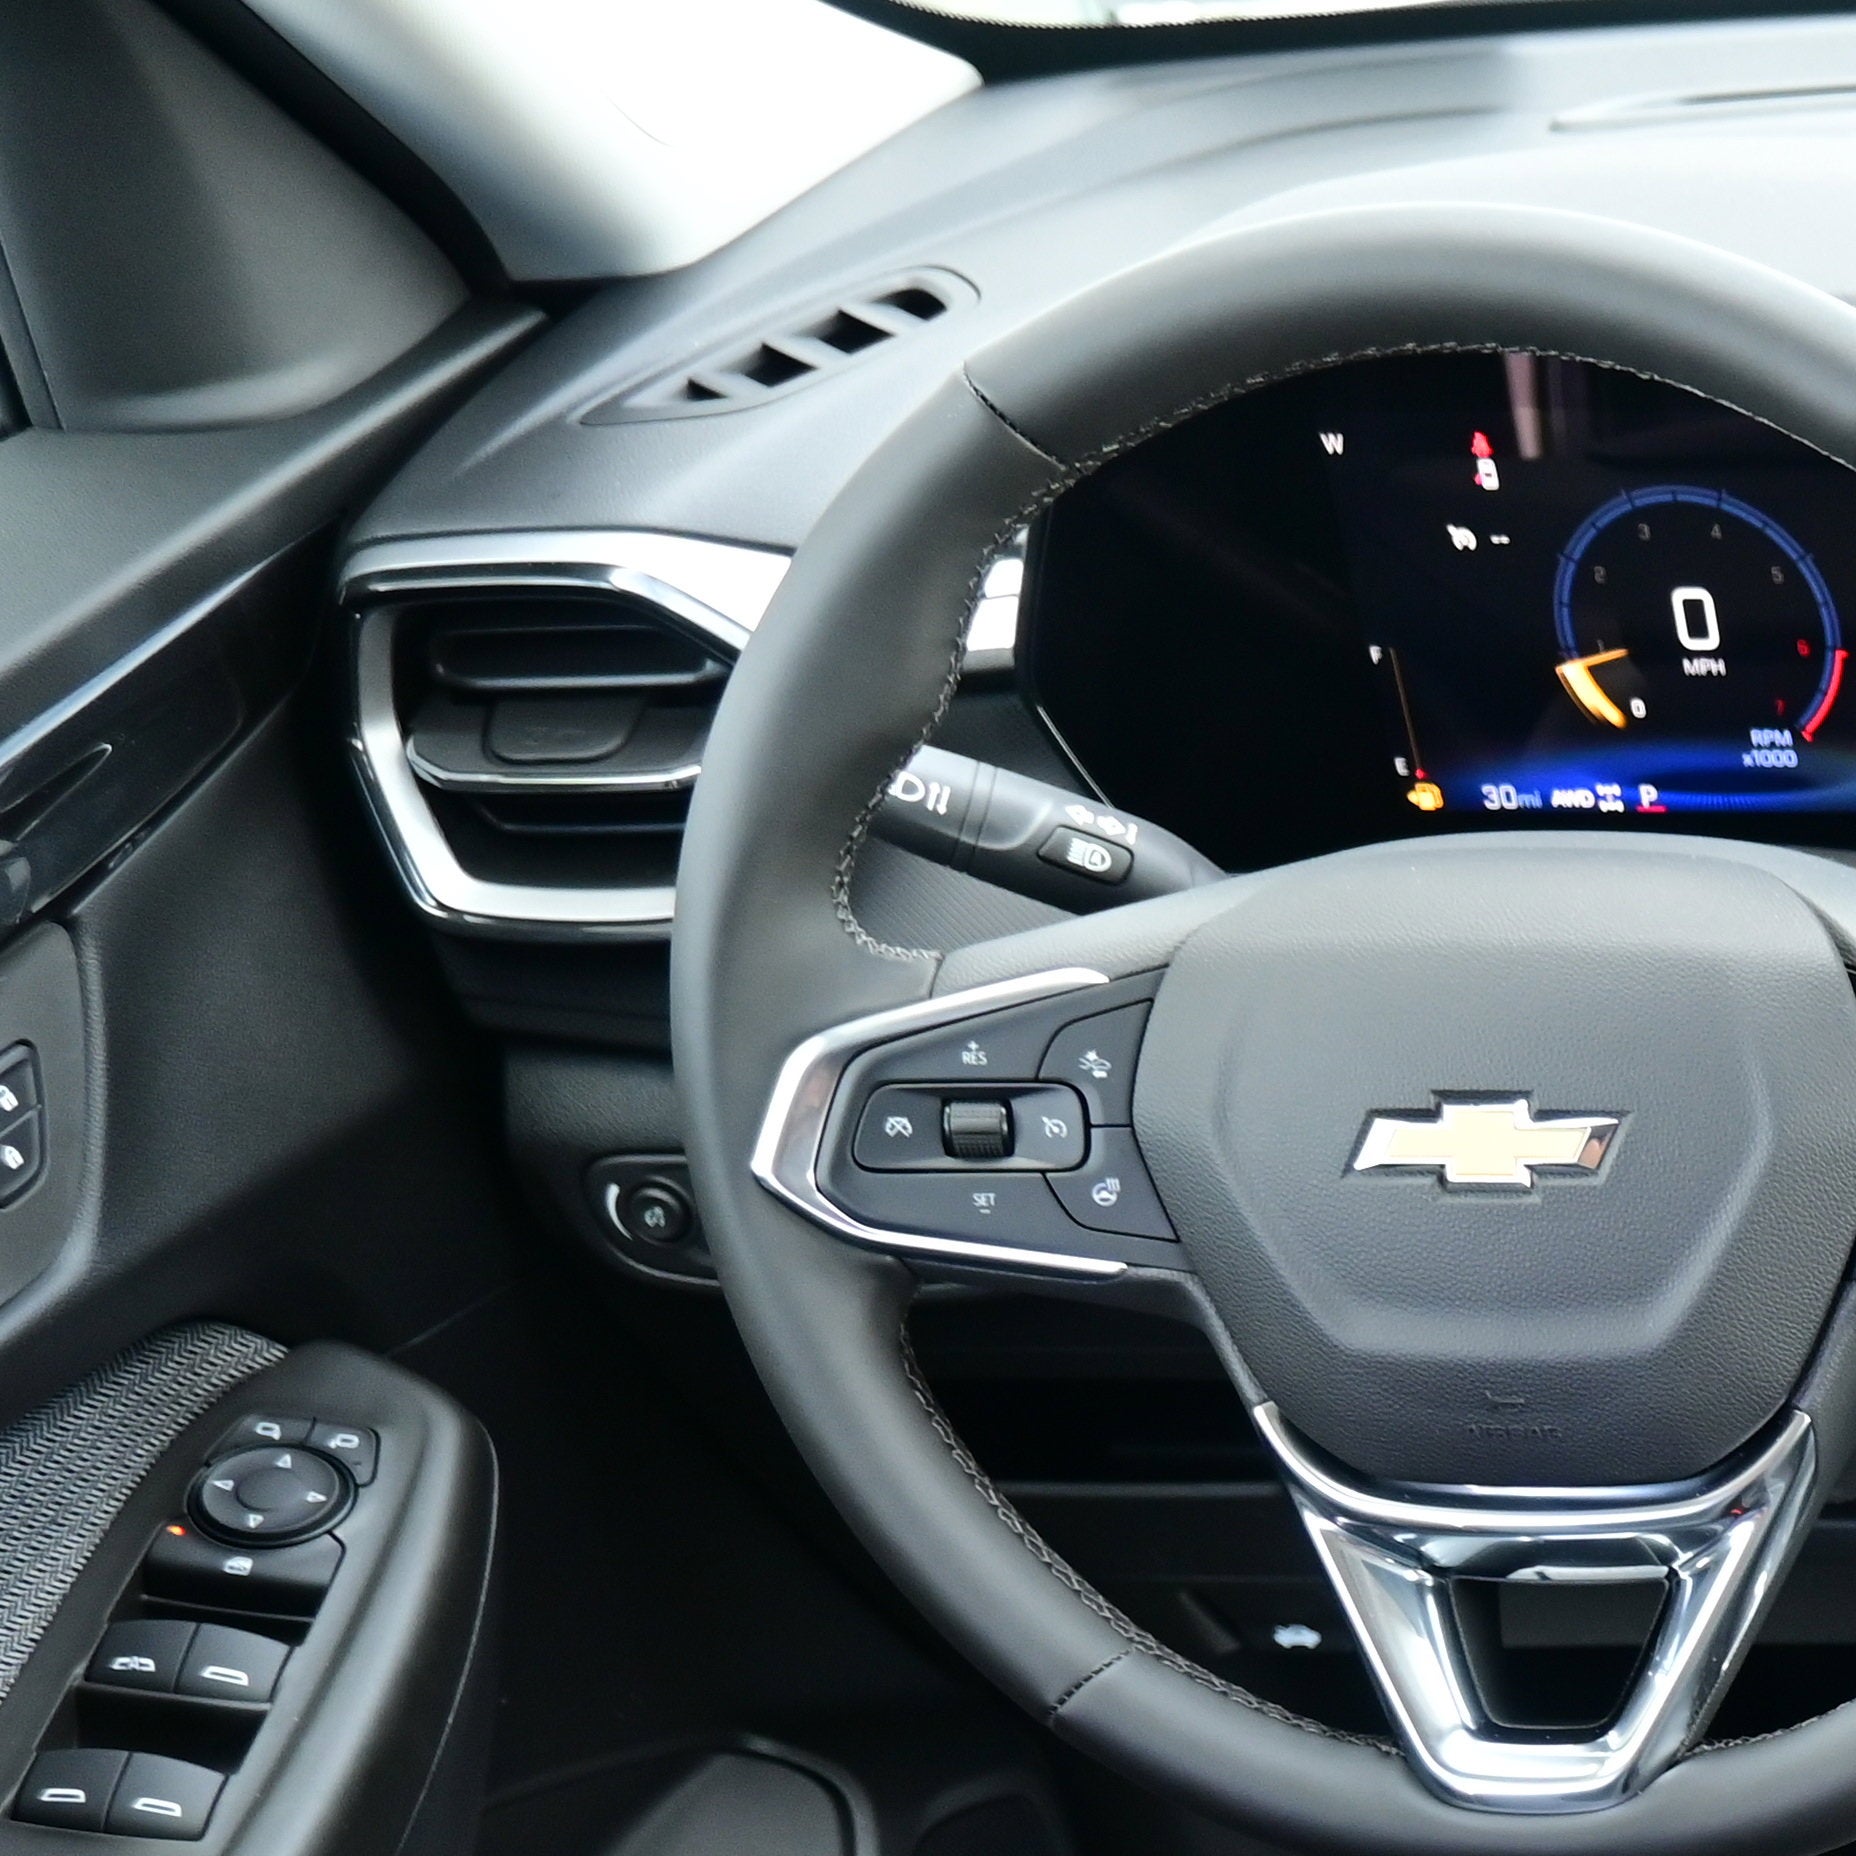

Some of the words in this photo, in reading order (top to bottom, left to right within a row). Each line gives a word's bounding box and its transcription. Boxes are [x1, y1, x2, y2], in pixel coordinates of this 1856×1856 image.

[1319, 431, 1344, 455] W
[1638, 523, 1650, 541] 3
[1710, 523, 1722, 540] 4
[1593, 565, 1606, 584] 2
[1771, 565, 1784, 585] 5
[1671, 586, 1721, 651] 0
[1796, 639, 1811, 656] 6
[1682, 658, 1727, 677] MPH
[1629, 697, 1647, 719] 0
[1750, 728, 1793, 747] RPM
[1393, 757, 1411, 777] E
[1639, 783, 1658, 807] P
[961, 1051, 988, 1066] RES
[972, 1192, 997, 1208] SET
